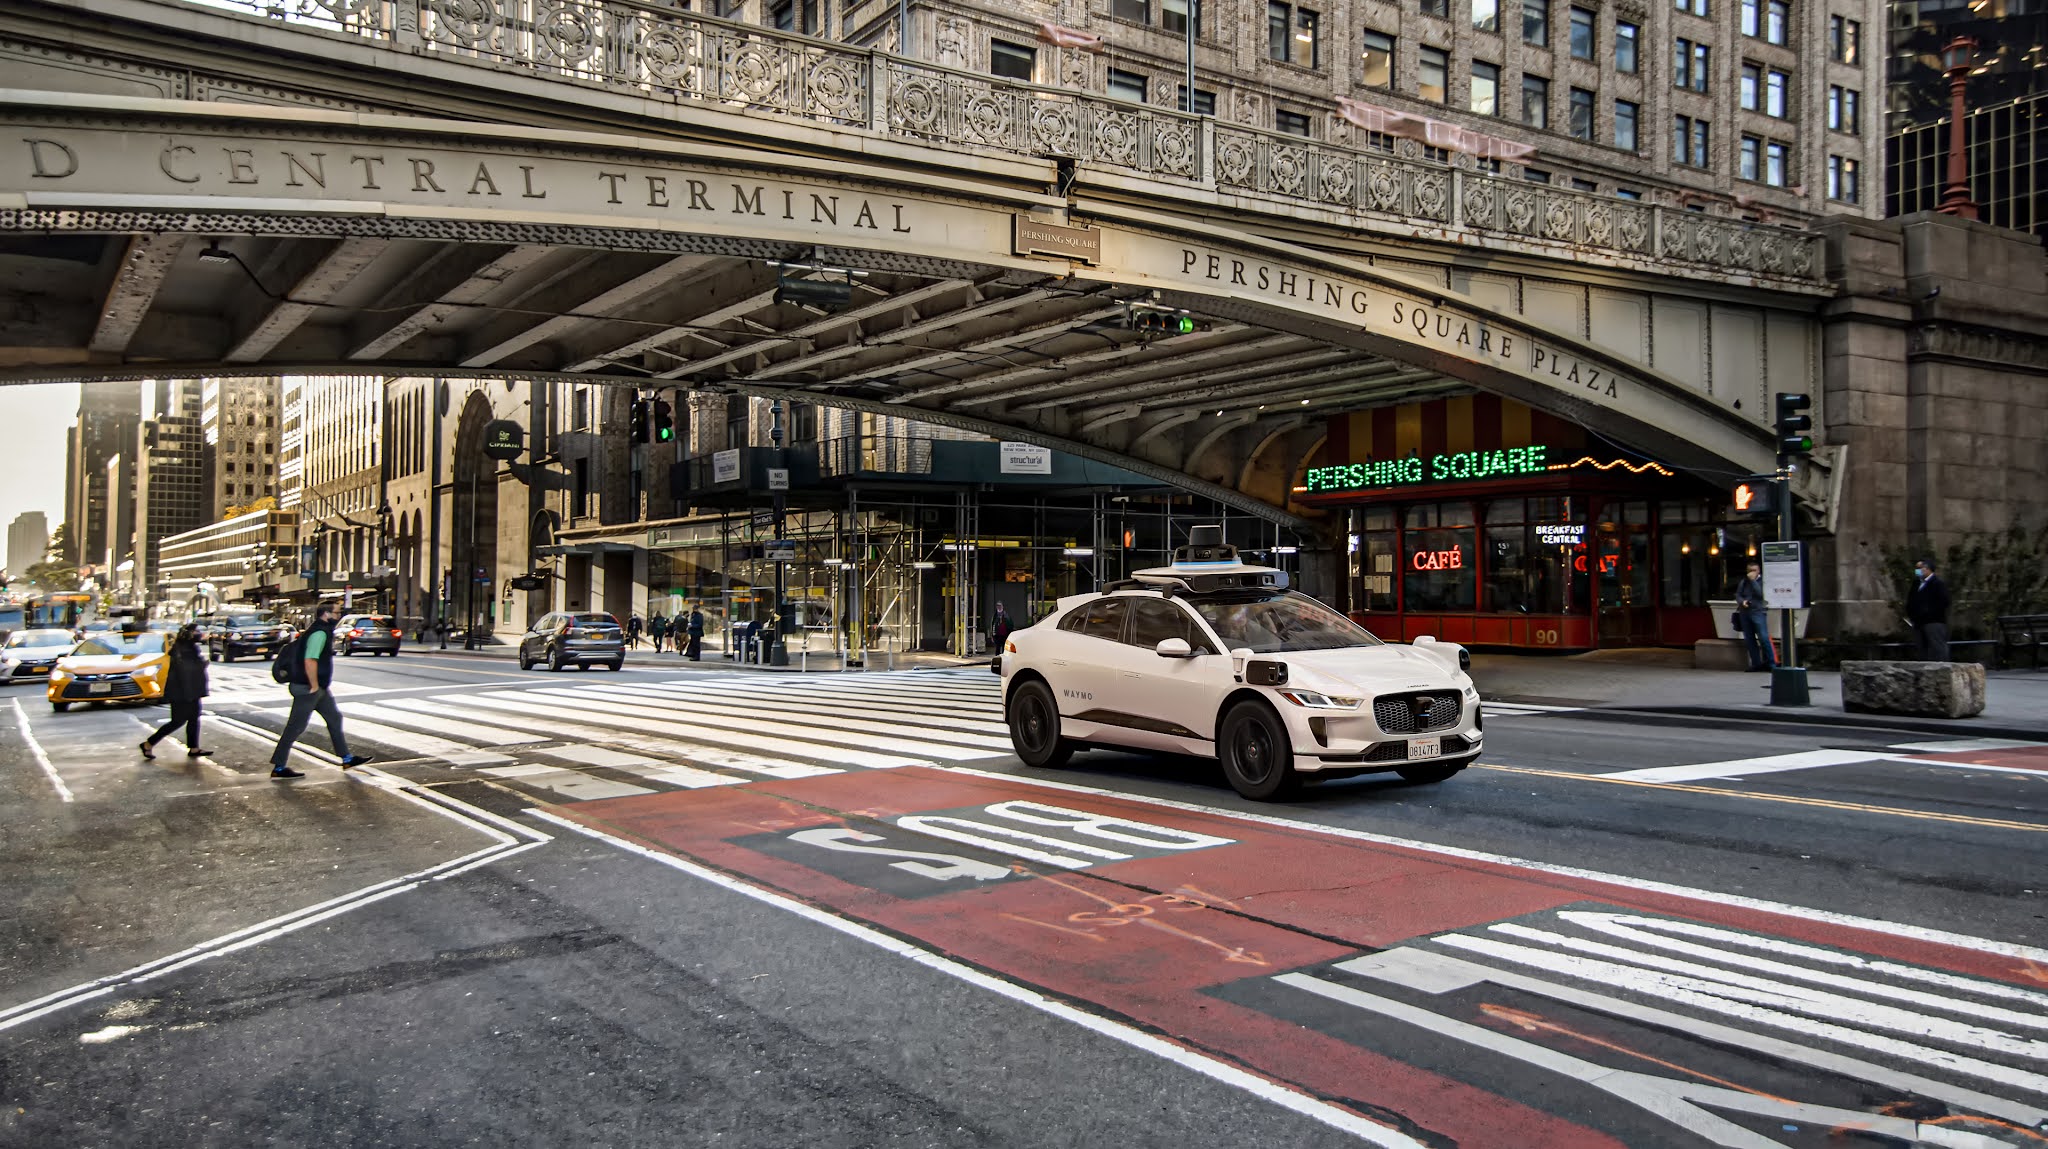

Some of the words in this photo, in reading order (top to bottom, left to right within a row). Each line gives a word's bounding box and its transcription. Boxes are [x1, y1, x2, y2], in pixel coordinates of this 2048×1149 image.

[160, 144, 547, 199] CENTRAL
[598, 170, 911, 234] TERMINAL
[1021, 229, 1064, 244] PERSHING
[1065, 236, 1098, 249] SQUARE
[1181, 248, 1369, 314] PERSHING
[1392, 302, 1513, 359] SQUARE
[1533, 348, 1618, 399] PLAZA
[1307, 457, 1422, 491] PERSHING
[1432, 445, 1547, 480] SQUARE
[1535, 525, 1585, 535] BREAKFAST
[1541, 535, 1581, 544] CENTRAL
[1413, 544, 1462, 571] CAFÉ
[1536, 629, 1558, 645] 90
[1063, 688, 1093, 701] WAYMO
[787, 800, 1238, 881] BUS
[1270, 910, 2048, 1149] ONLY
